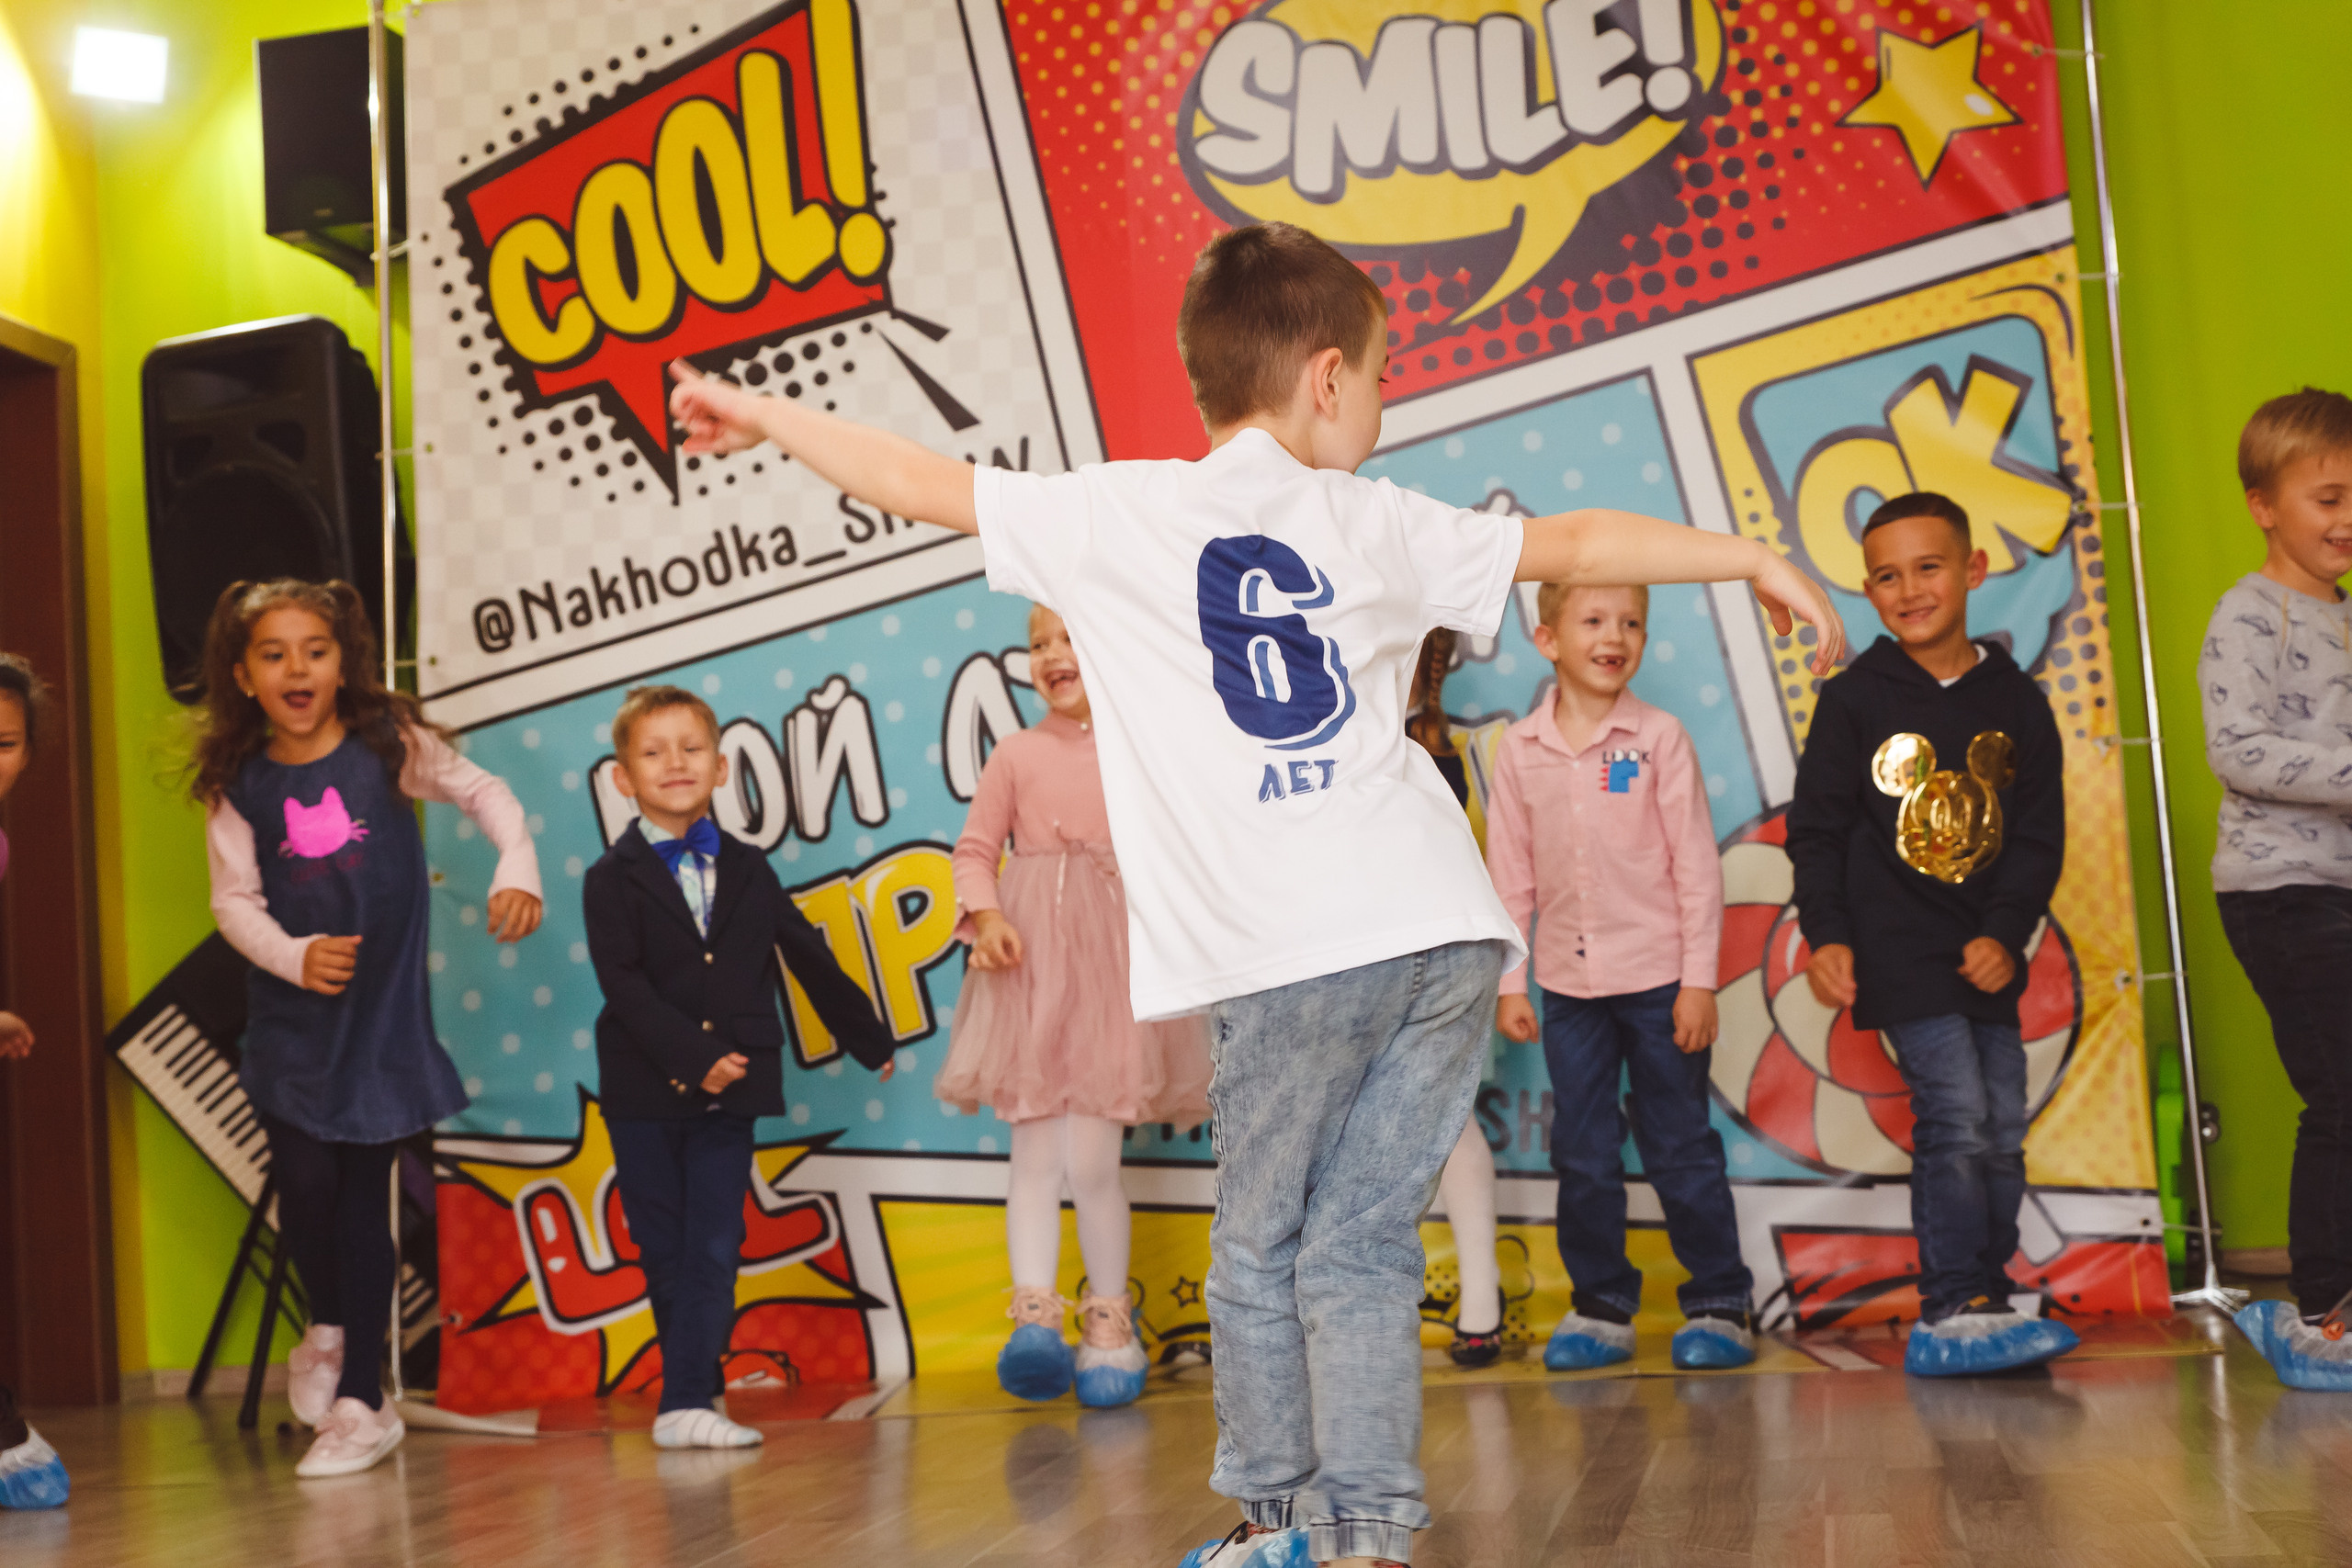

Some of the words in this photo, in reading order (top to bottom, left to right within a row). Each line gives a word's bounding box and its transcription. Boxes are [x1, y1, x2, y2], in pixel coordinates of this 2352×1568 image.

[486, 0, 891, 366] COOL!
[1193, 0, 1693, 198] SMILE!
[1197, 535, 1356, 750] 6
[1259, 759, 1339, 803] ЛЕТ
